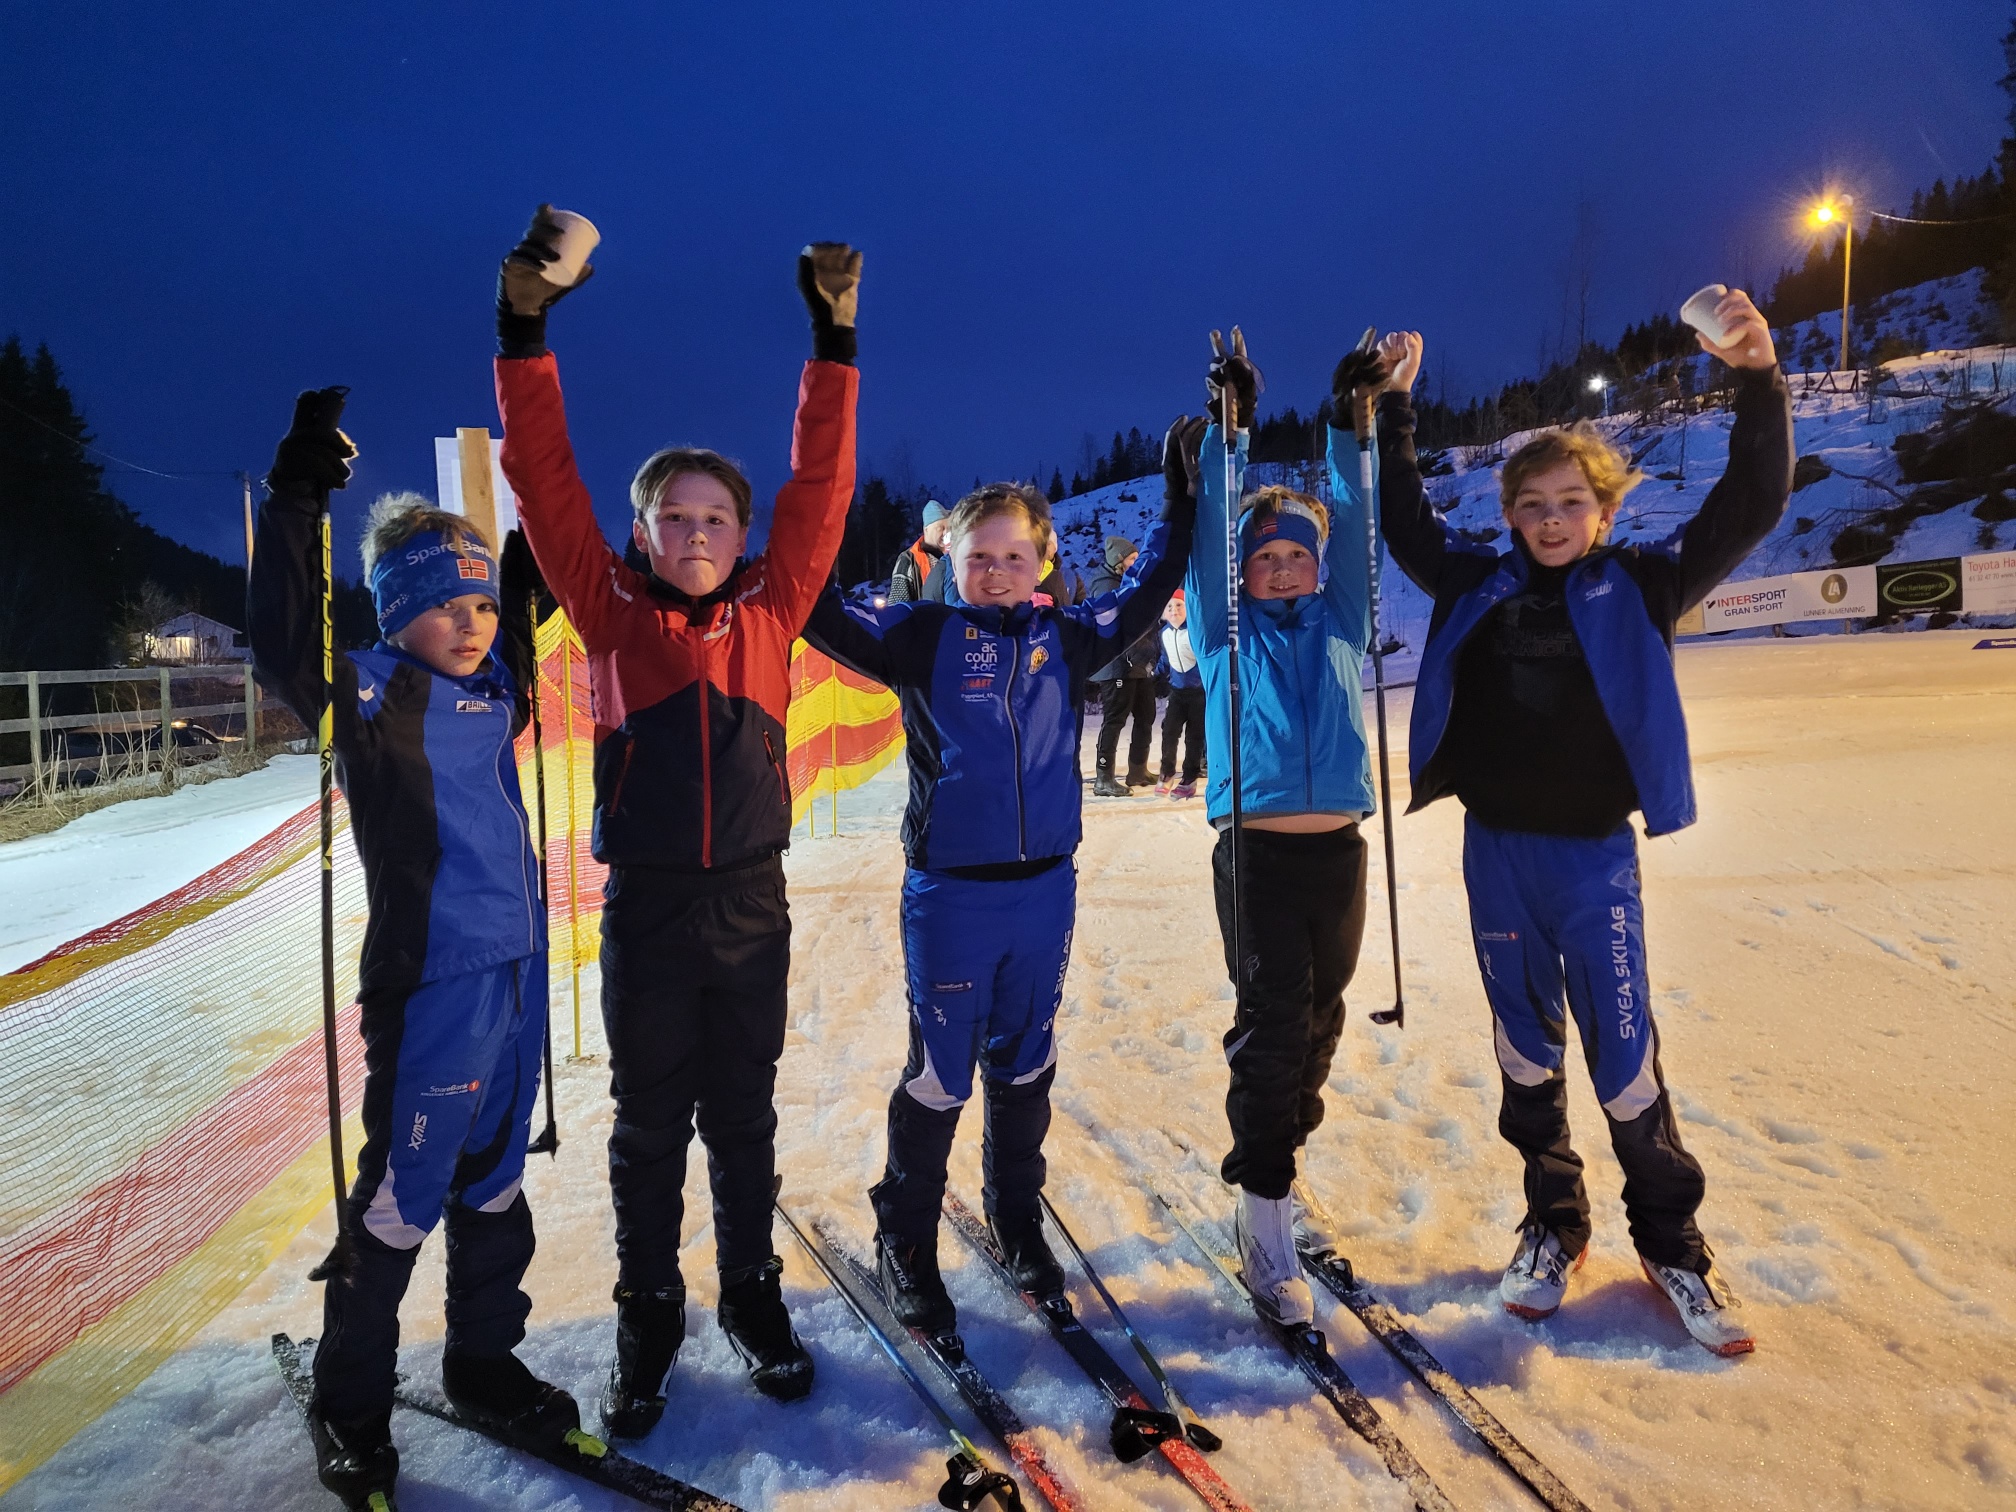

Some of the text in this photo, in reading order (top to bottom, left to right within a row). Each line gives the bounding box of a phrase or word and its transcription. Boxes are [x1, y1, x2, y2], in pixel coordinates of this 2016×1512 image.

[1967, 560, 2000, 573] Toyota
[1828, 581, 1841, 596] LA
[1717, 589, 1787, 608] INTERSPORT
[1724, 602, 1784, 617] GRAN SPORT
[1803, 609, 1827, 617] LUNNER
[981, 642, 998, 653] ac
[965, 652, 998, 663] coun
[1610, 906, 1631, 977] SKILAG
[1617, 982, 1636, 1040] SVEA
[430, 1083, 468, 1093] SpareBank
